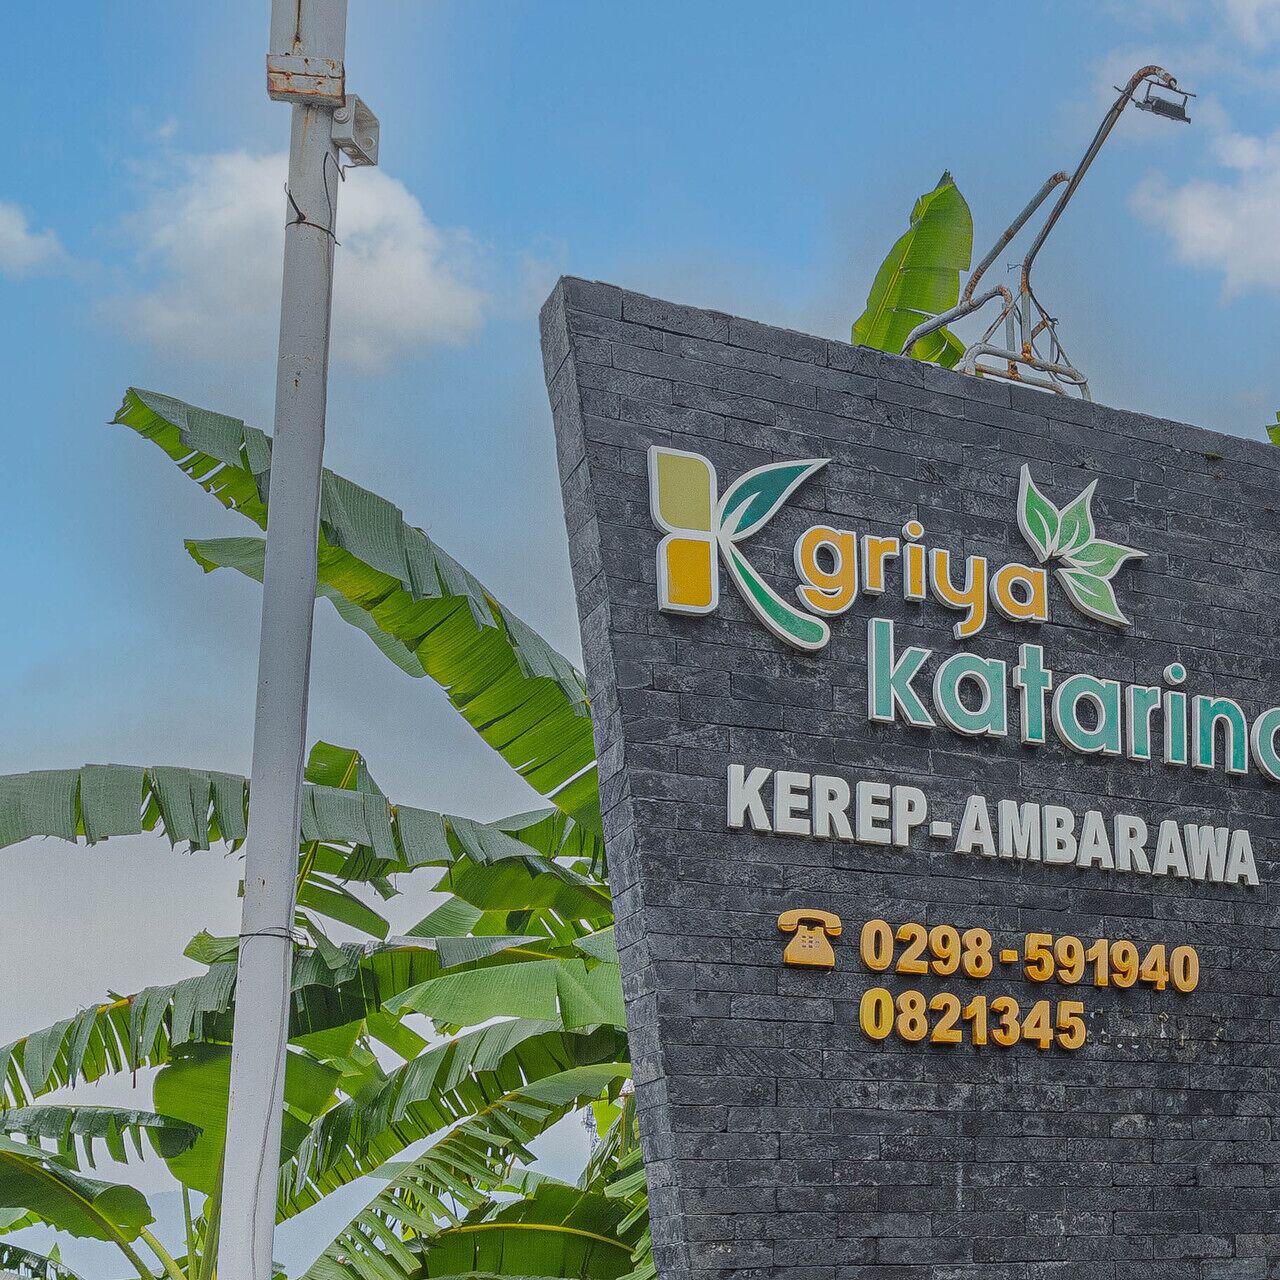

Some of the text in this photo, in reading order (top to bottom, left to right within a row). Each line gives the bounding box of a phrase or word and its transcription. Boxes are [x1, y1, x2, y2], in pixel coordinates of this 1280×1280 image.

[794, 519, 1048, 640] griya
[726, 763, 1261, 886] KEREP-AMBARAWA
[859, 987, 1087, 1050] 0821345
